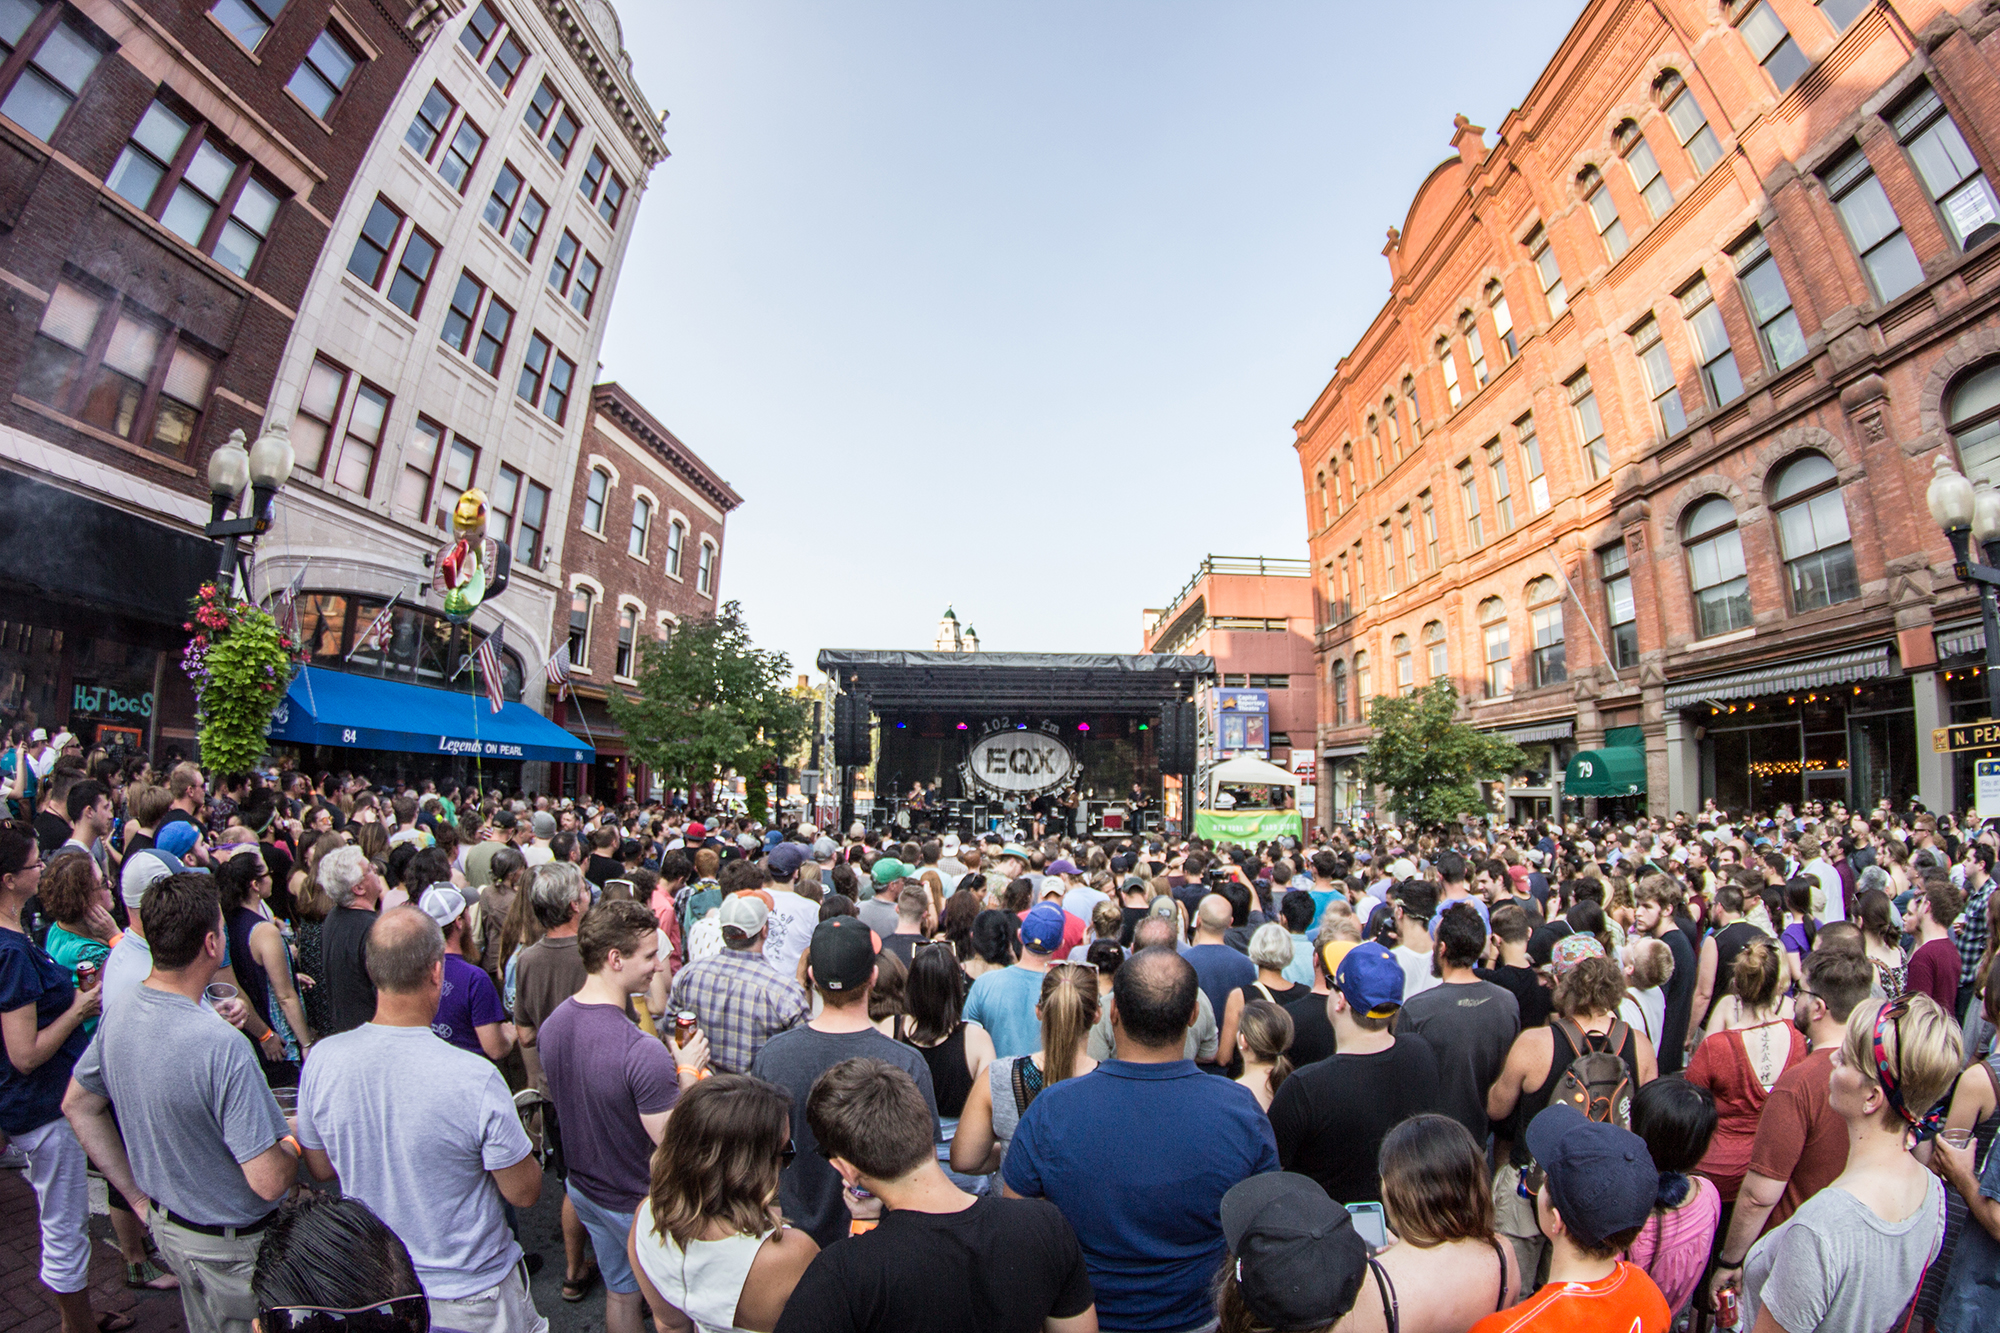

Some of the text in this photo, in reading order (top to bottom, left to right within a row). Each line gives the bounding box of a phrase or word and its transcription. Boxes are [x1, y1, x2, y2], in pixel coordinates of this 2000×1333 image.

[343, 728, 357, 743] 84
[1955, 730, 1969, 746] N.
[438, 735, 523, 757] Legends ON PEARL
[986, 747, 1056, 777] EQX
[1578, 761, 1593, 778] 79
